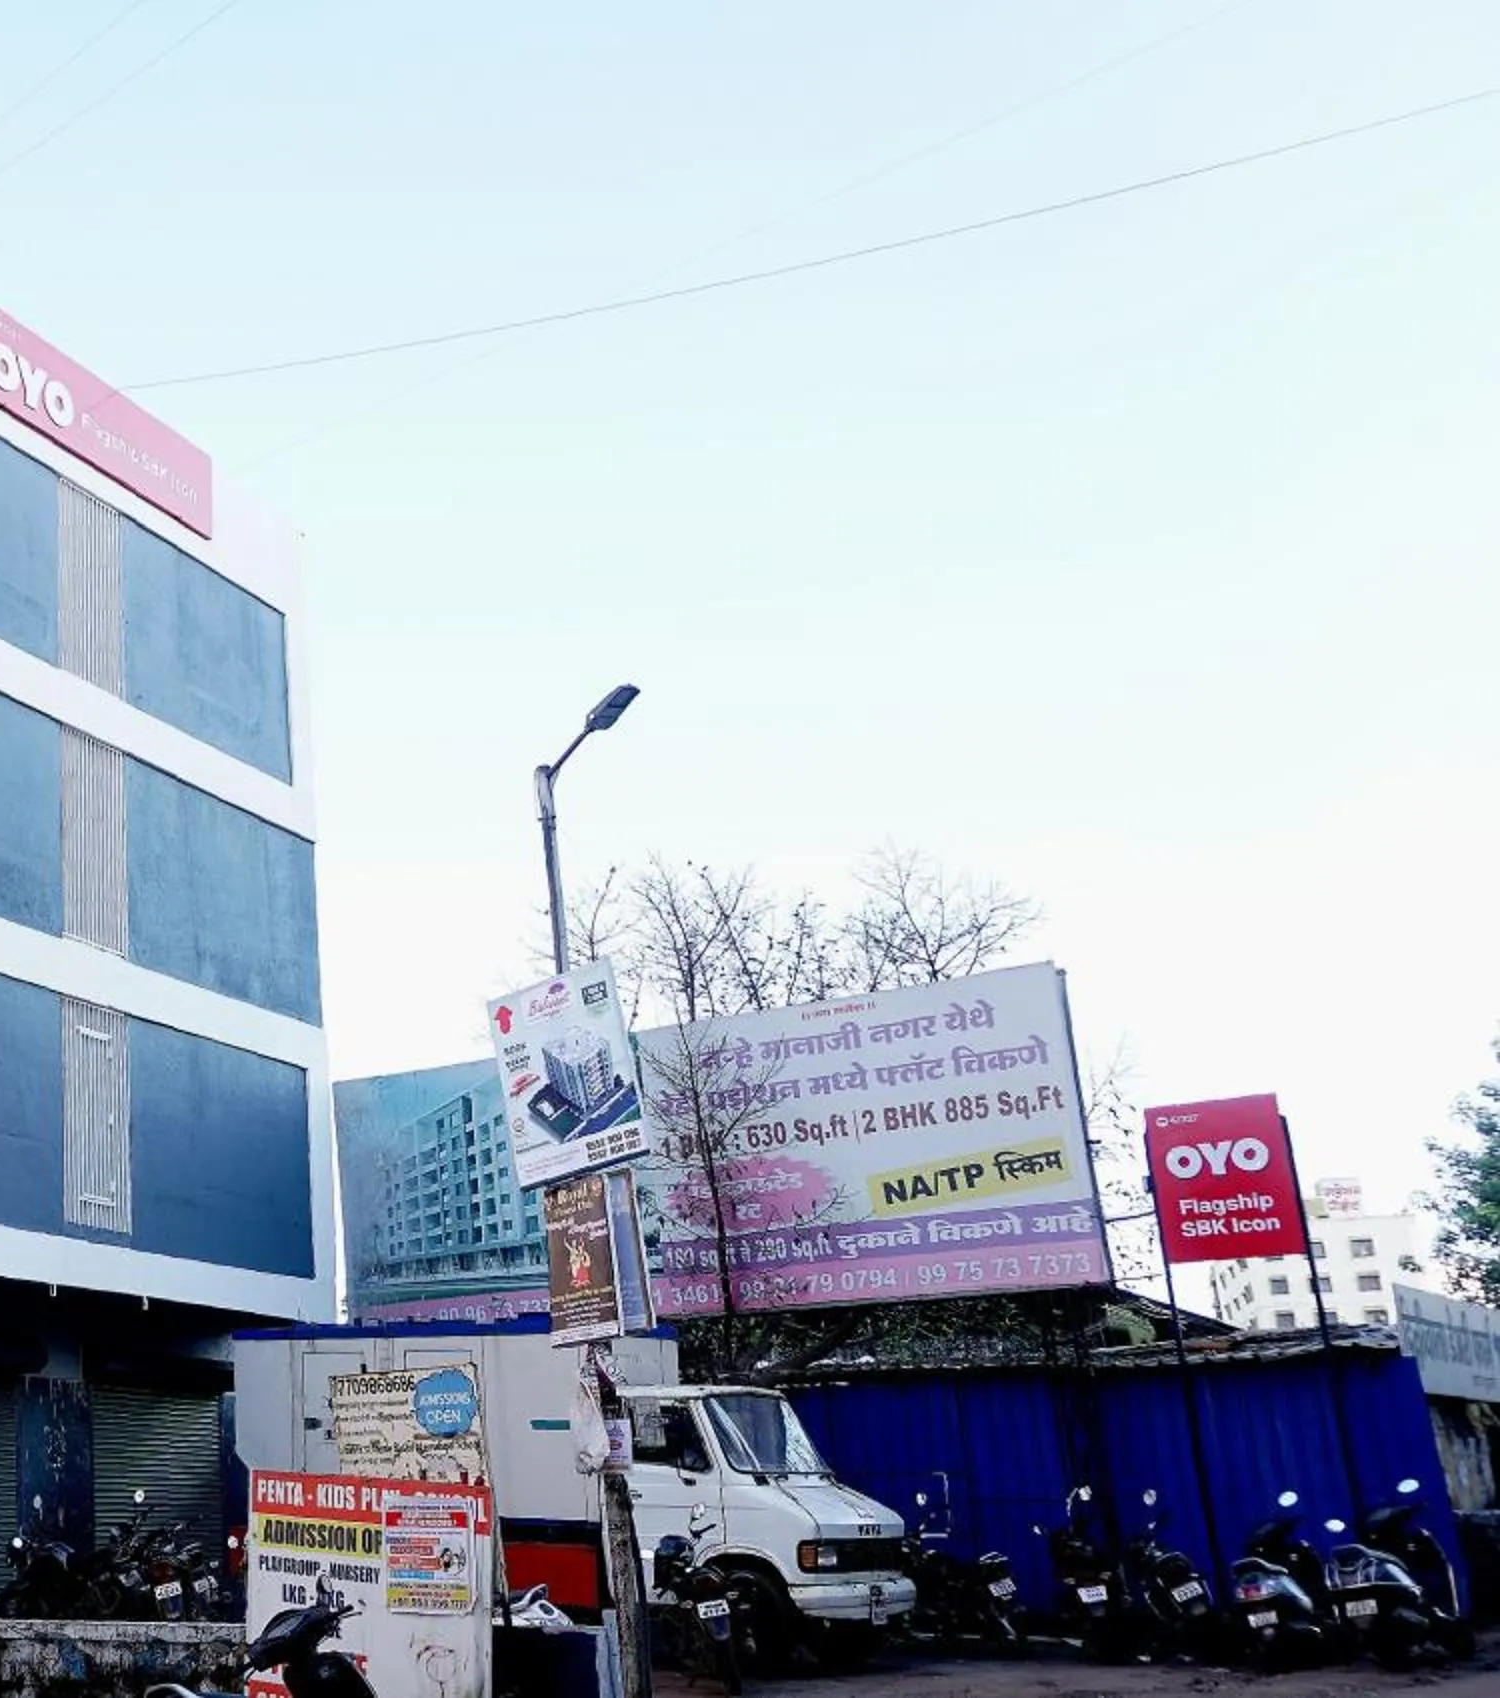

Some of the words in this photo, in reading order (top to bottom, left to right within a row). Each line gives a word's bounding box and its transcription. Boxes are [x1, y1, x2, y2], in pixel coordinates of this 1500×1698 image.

[867, 1015, 937, 1044] नगर
[941, 998, 996, 1032] येथे
[807, 1061, 869, 1096] मध्ये
[875, 1052, 945, 1087] फ्लॅट
[951, 1034, 1049, 1077] विकणे
[747, 1121, 787, 1148] 630
[794, 1113, 849, 1146] Sq.ft
[861, 1110, 877, 1134] 2
[883, 1101, 938, 1131] BHK
[945, 1093, 990, 1123] 885
[997, 1084, 1065, 1120] Sq.Ft
[1165, 1137, 1270, 1180] OYO
[882, 1162, 985, 1205] NA/TP
[993, 1151, 1063, 1182] स्किम
[1178, 1191, 1275, 1216] Flagship
[836, 1220, 922, 1260] दुकाने
[927, 1211, 1024, 1244] विकणे
[1031, 1205, 1094, 1234] आहे
[1180, 1218, 1230, 1238] SBK
[1231, 1214, 1282, 1234] Icon
[841, 1267, 897, 1292] 0794
[917, 1263, 947, 1286] 99
[954, 1260, 983, 1281] 75
[992, 1257, 1021, 1278] 73
[1029, 1252, 1091, 1276] 7373
[425, 1409, 462, 1425] OPEN
[257, 1478, 304, 1507] PENTA
[316, 1483, 356, 1511] KIDS
[263, 1518, 358, 1553] ADMISSION
[259, 1555, 321, 1578] PLAYGROUP
[329, 1561, 381, 1586] NURSERY
[282, 1583, 308, 1606] LKG
